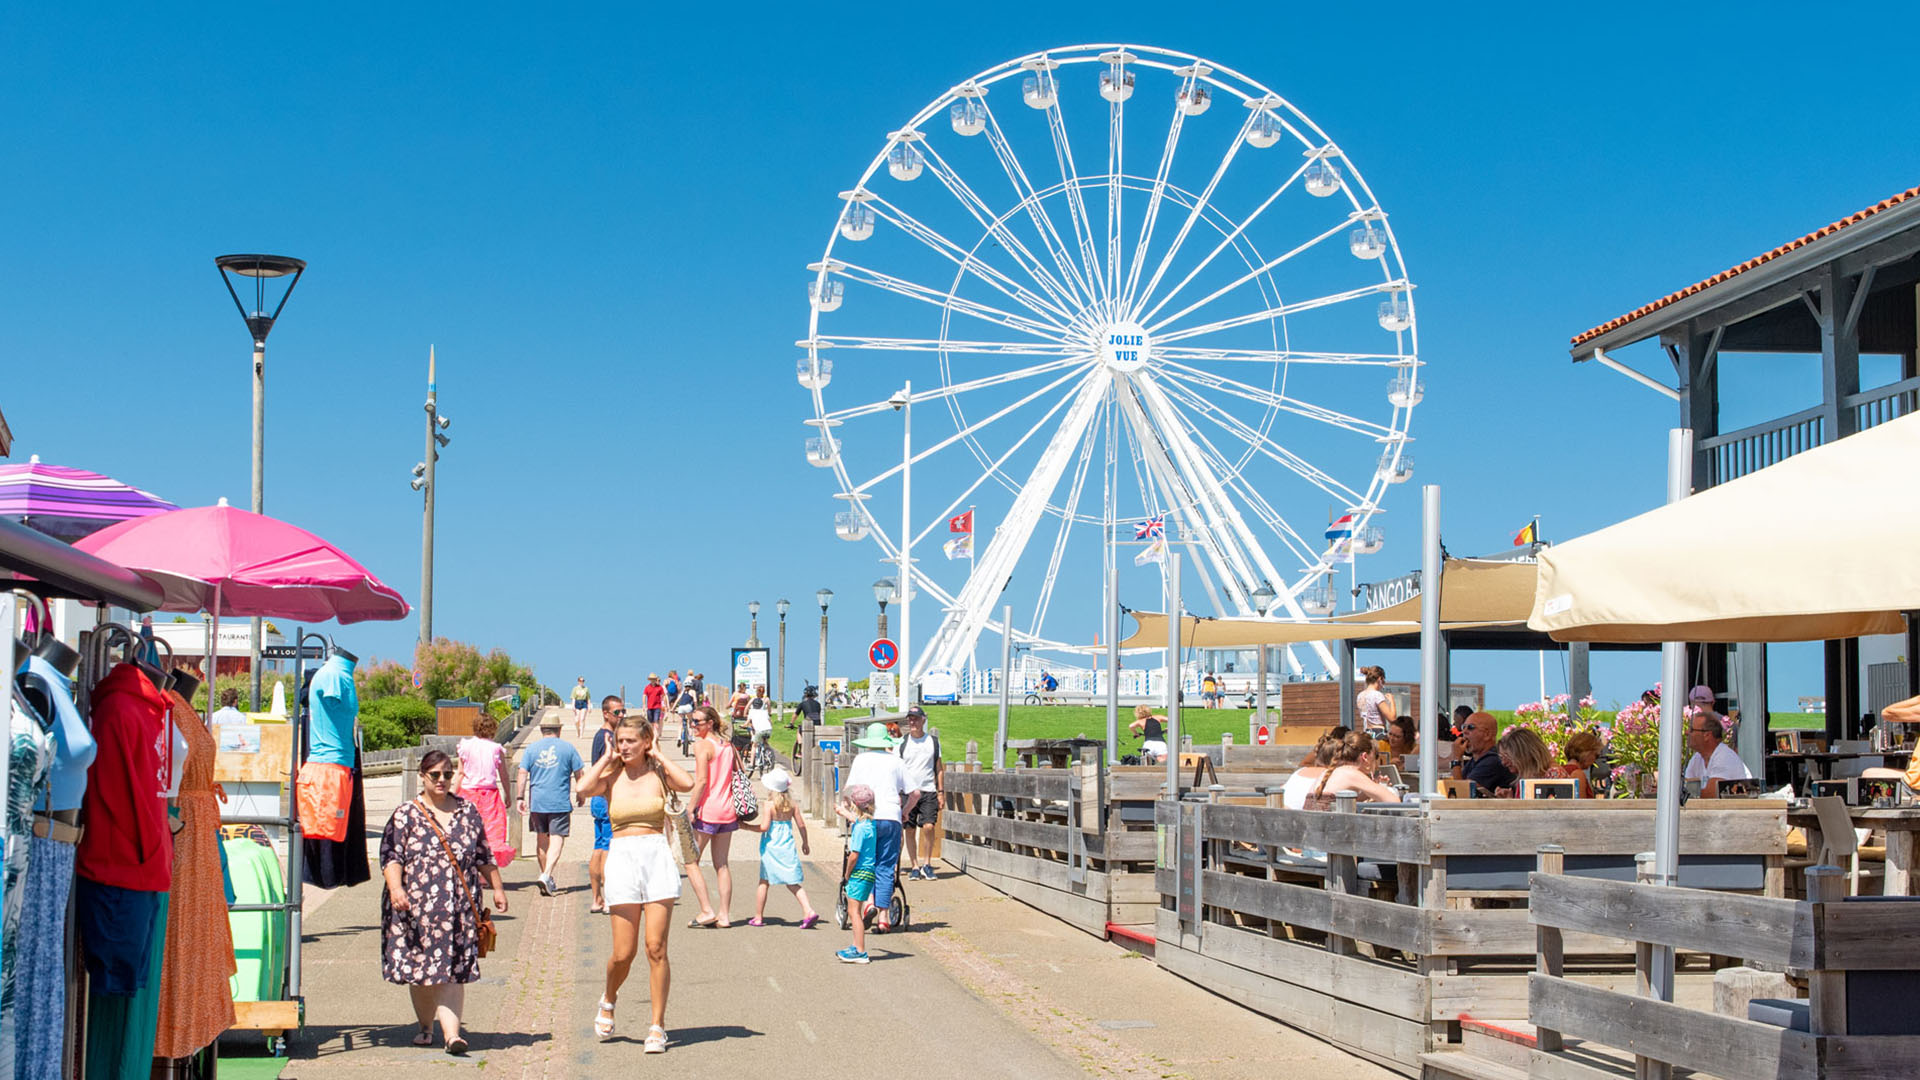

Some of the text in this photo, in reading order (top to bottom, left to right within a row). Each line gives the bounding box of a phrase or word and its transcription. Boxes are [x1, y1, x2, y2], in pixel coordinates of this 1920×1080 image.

[1108, 334, 1143, 346] JOLIE
[1115, 350, 1138, 361] VUE
[1366, 580, 1404, 612] SANGO
